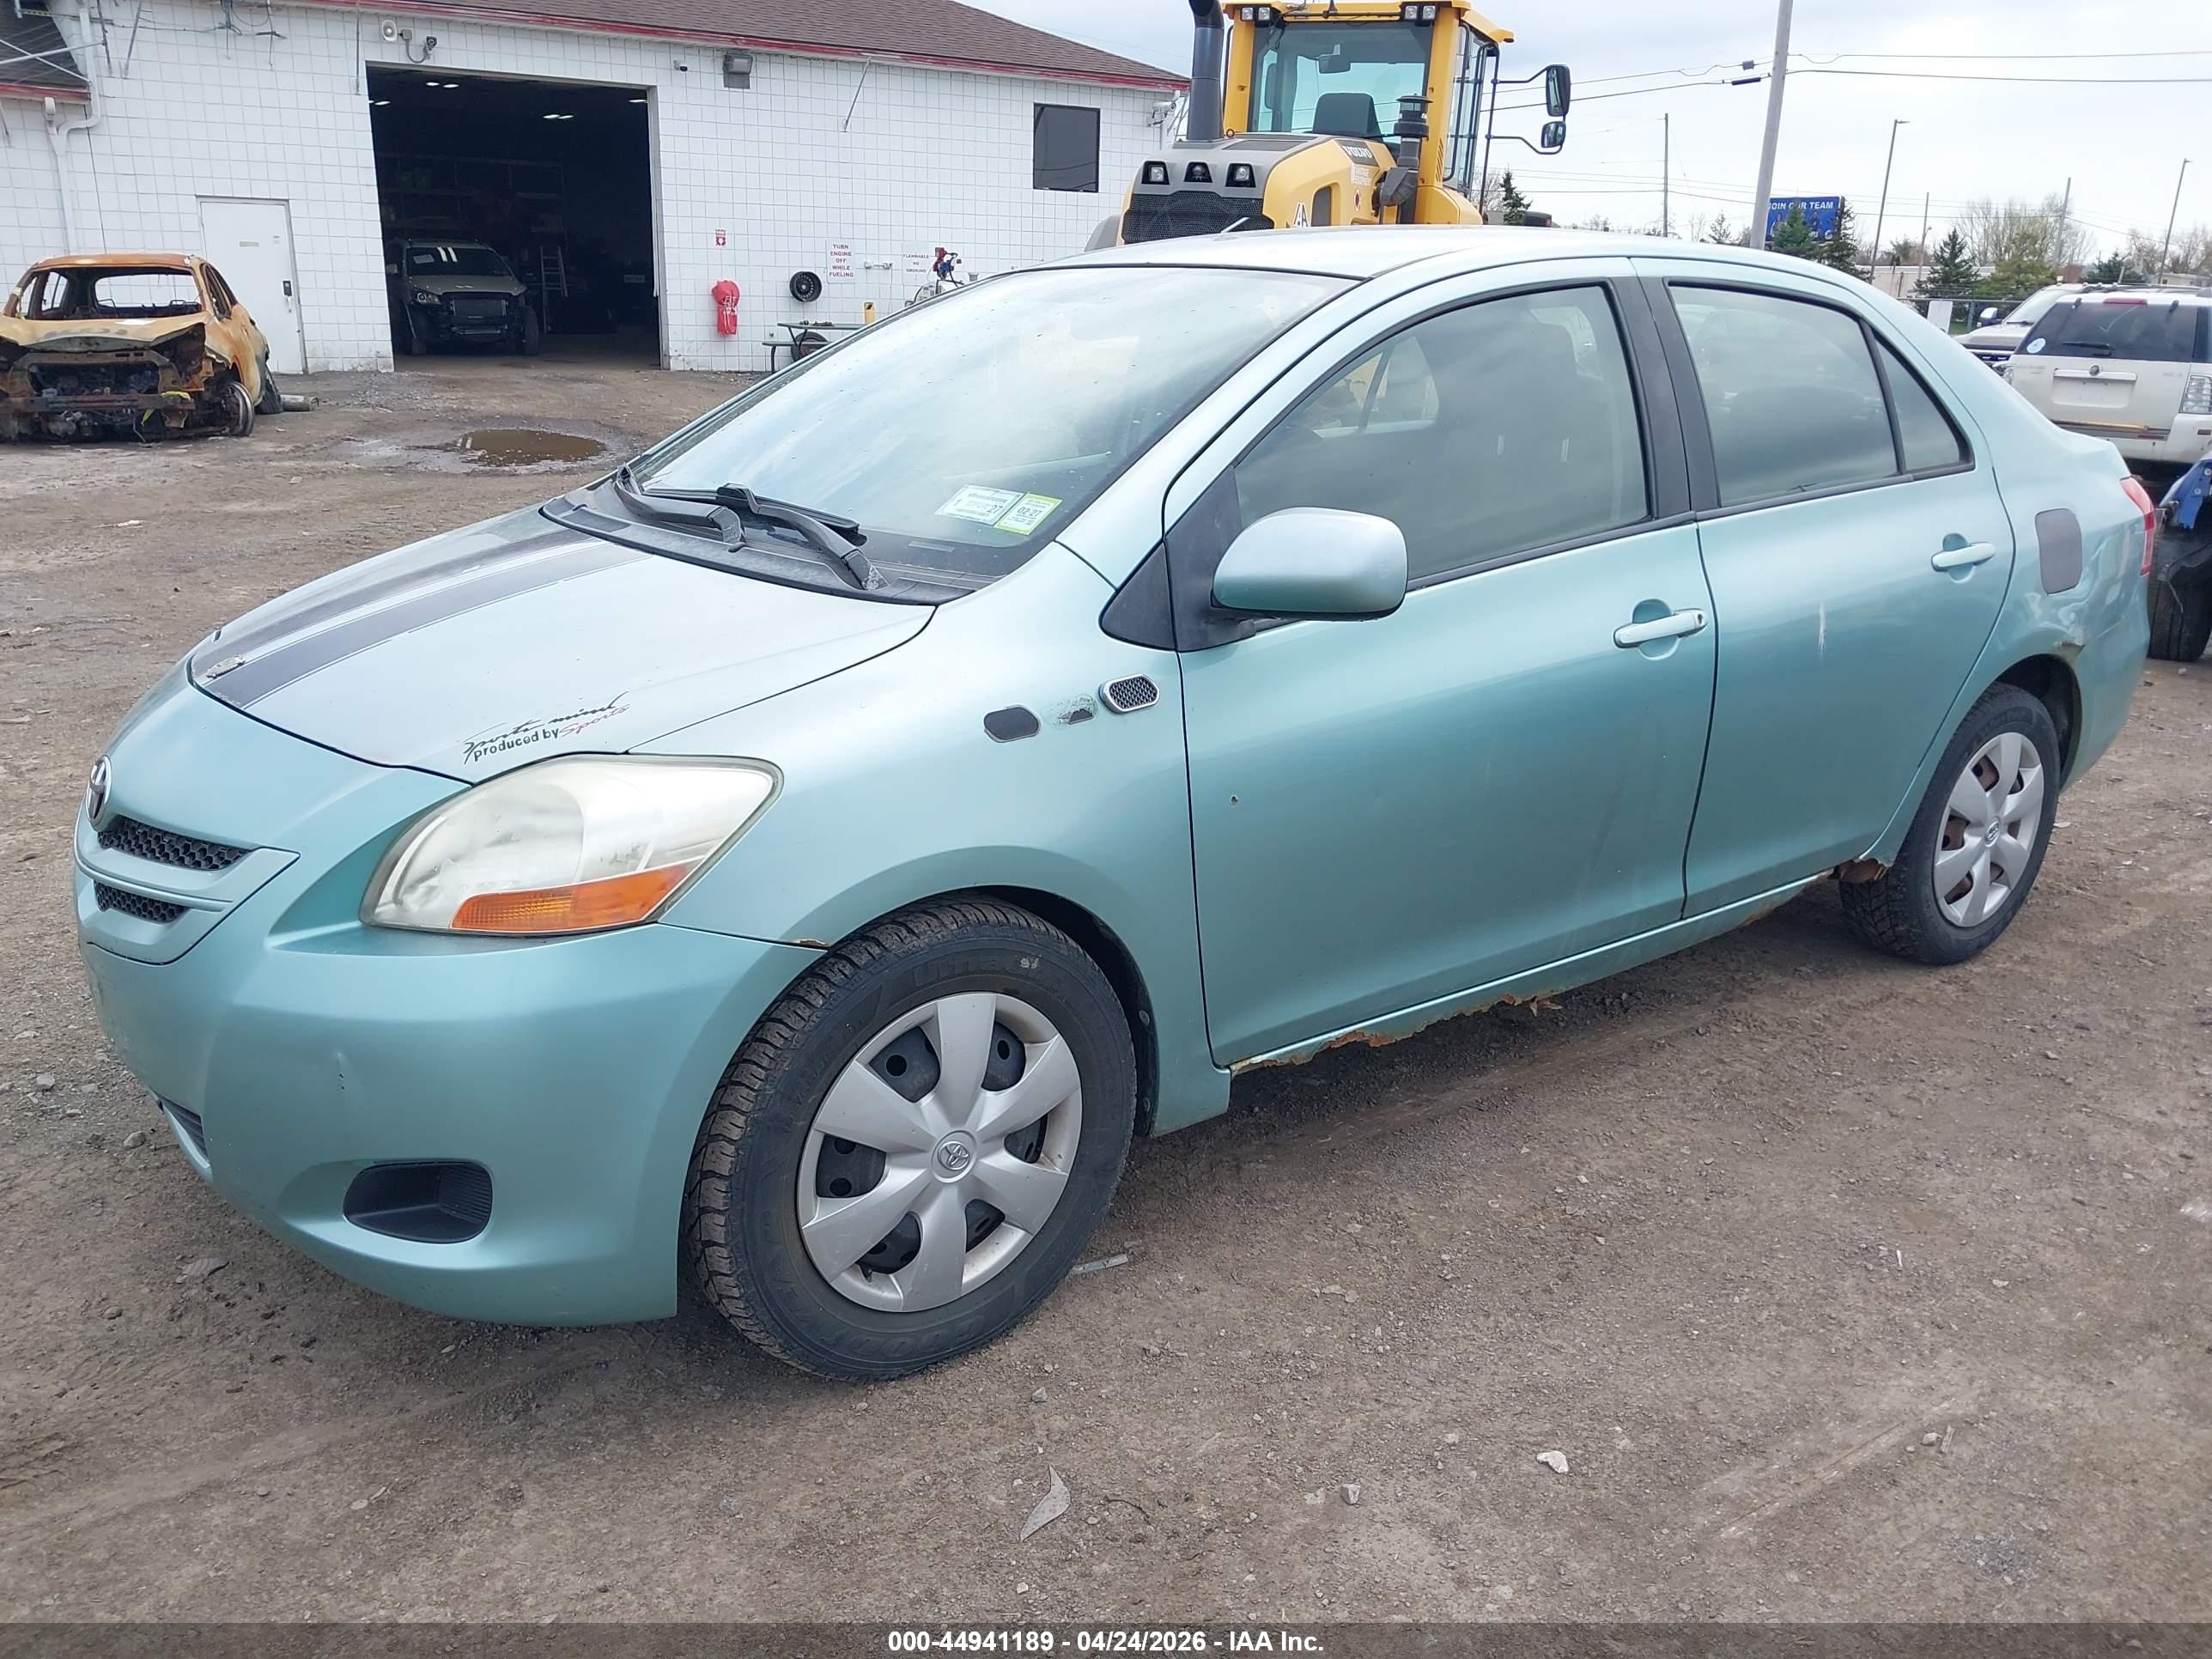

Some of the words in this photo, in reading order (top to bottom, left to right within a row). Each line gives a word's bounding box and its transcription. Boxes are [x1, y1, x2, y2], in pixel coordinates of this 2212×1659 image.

[1342, 145, 1372, 159] VOLVO
[1809, 201, 1833, 210] TEAM
[473, 731, 539, 762] produced
[543, 727, 560, 739] by
